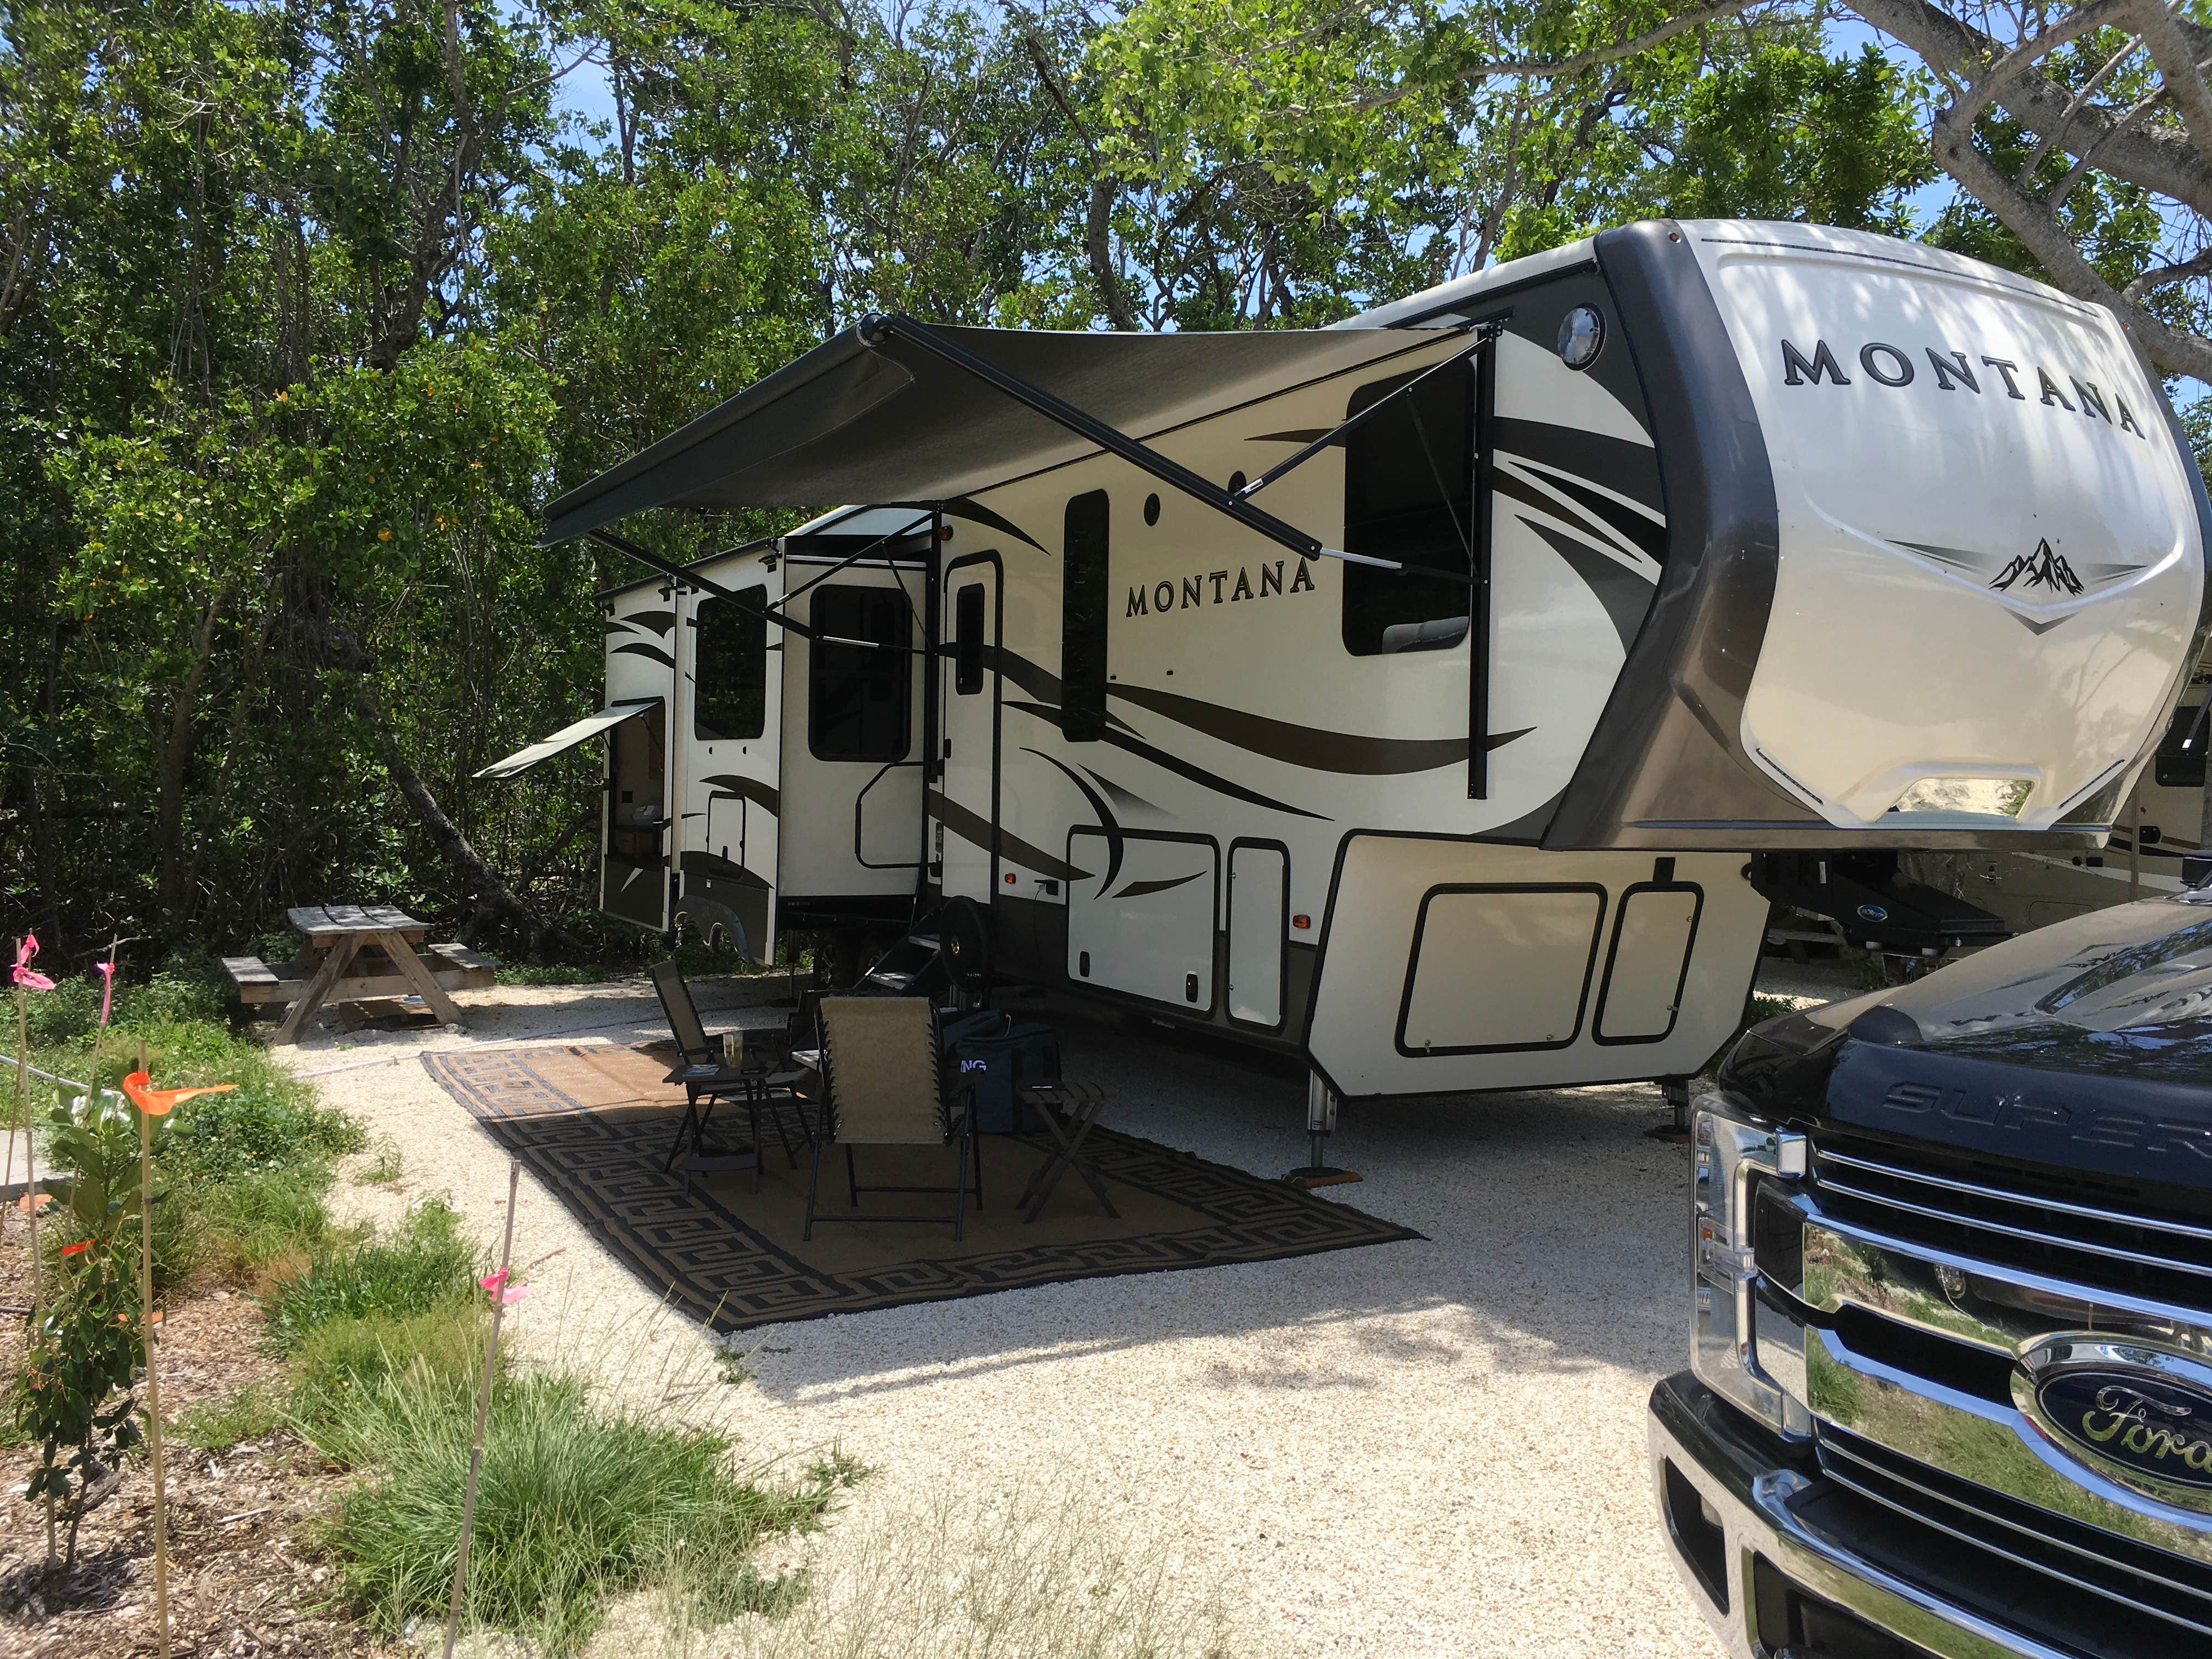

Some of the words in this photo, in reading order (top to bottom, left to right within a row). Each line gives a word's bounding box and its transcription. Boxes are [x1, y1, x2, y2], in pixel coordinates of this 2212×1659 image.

[1781, 339, 2146, 439] MONTANA
[1126, 556, 1316, 618] MONTANA
[1882, 1081, 2212, 1159] SUPER
